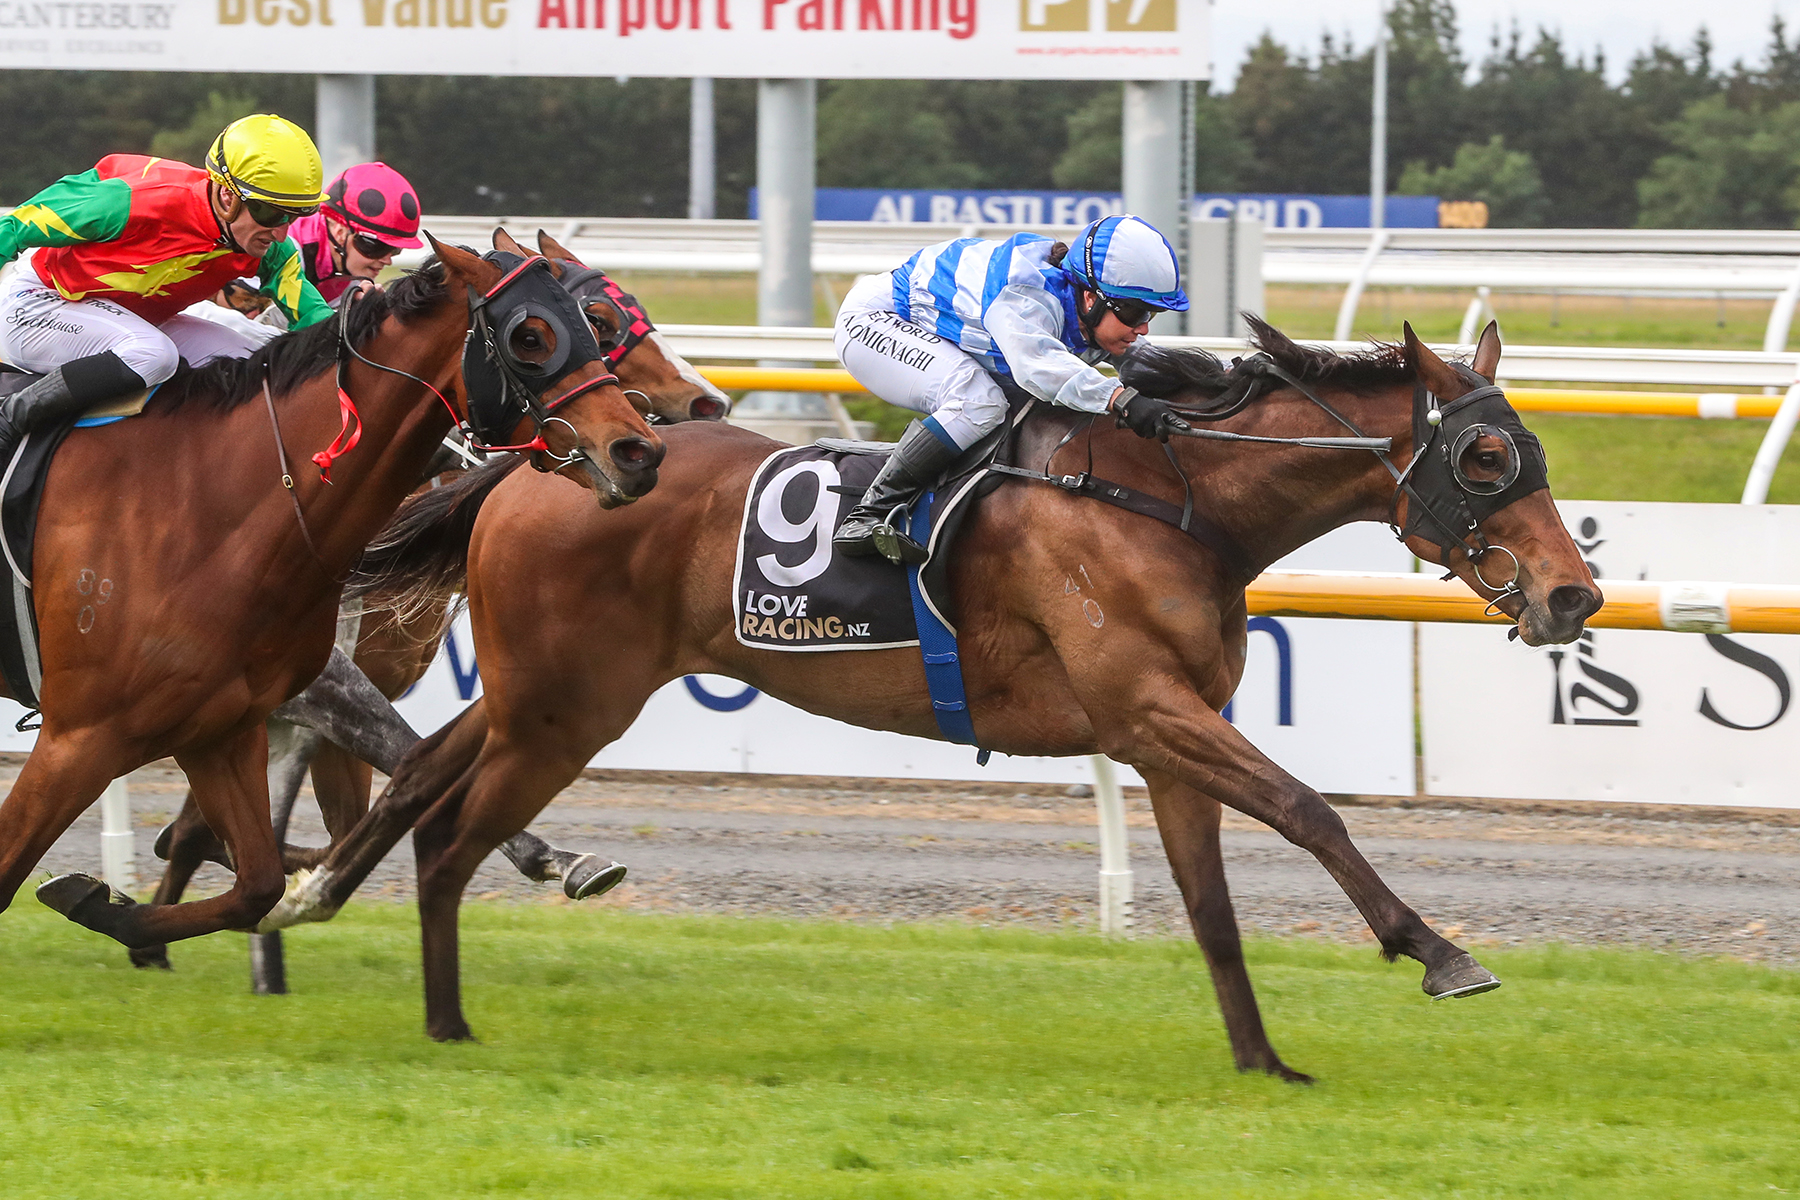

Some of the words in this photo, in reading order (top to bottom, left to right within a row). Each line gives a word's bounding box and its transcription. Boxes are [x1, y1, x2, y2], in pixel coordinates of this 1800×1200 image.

[755, 460, 842, 587] 9
[745, 590, 808, 617] LOVE
[742, 613, 871, 640] RACING.NZ
